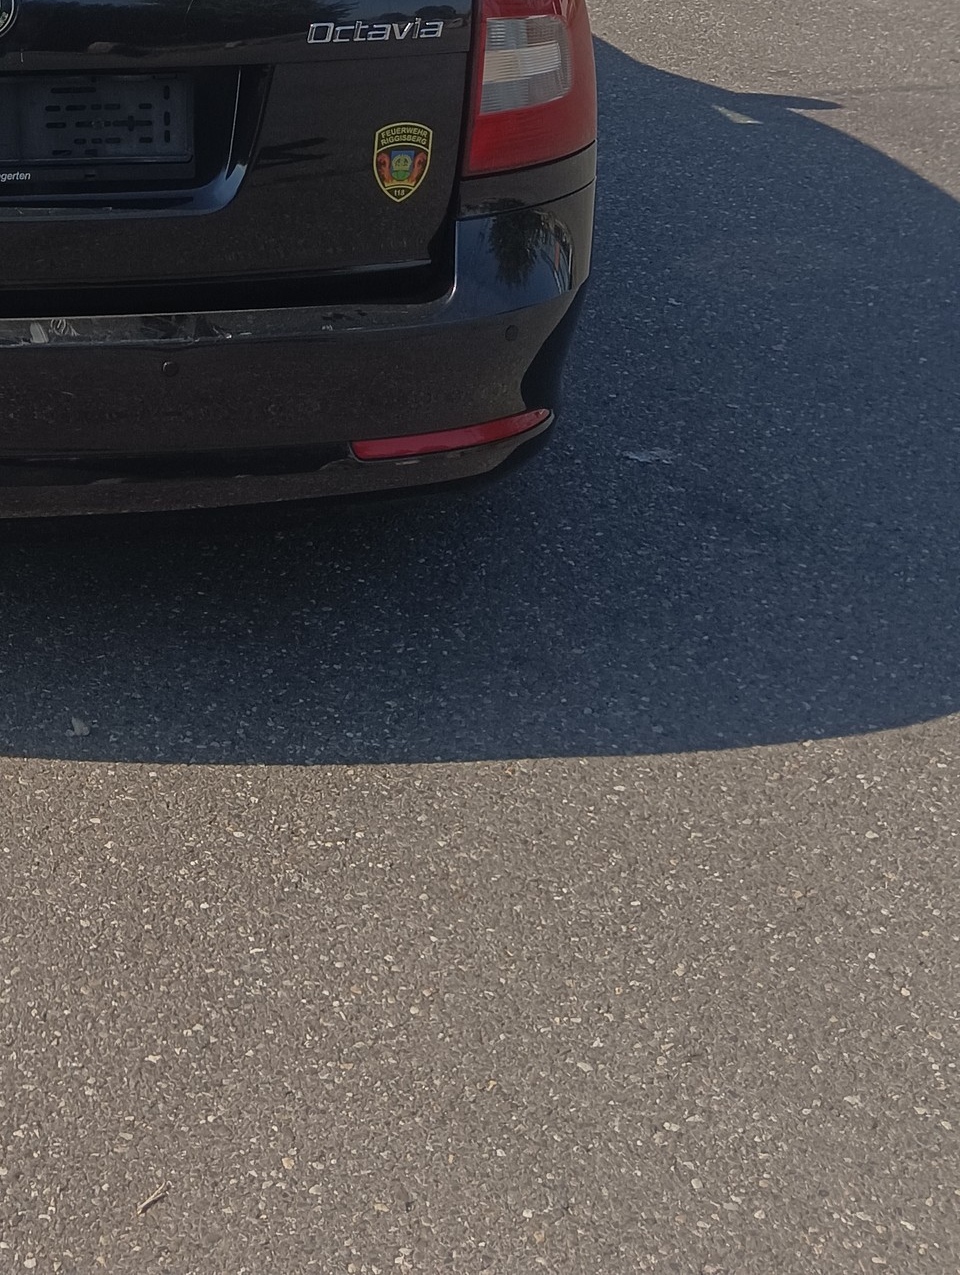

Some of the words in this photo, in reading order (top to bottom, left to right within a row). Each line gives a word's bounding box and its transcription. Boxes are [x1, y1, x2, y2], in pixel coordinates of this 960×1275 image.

[307, 17, 444, 44] Octavia
[381, 127, 428, 139] FEUERWEHR
[381, 134, 428, 146] RIGGISBERG
